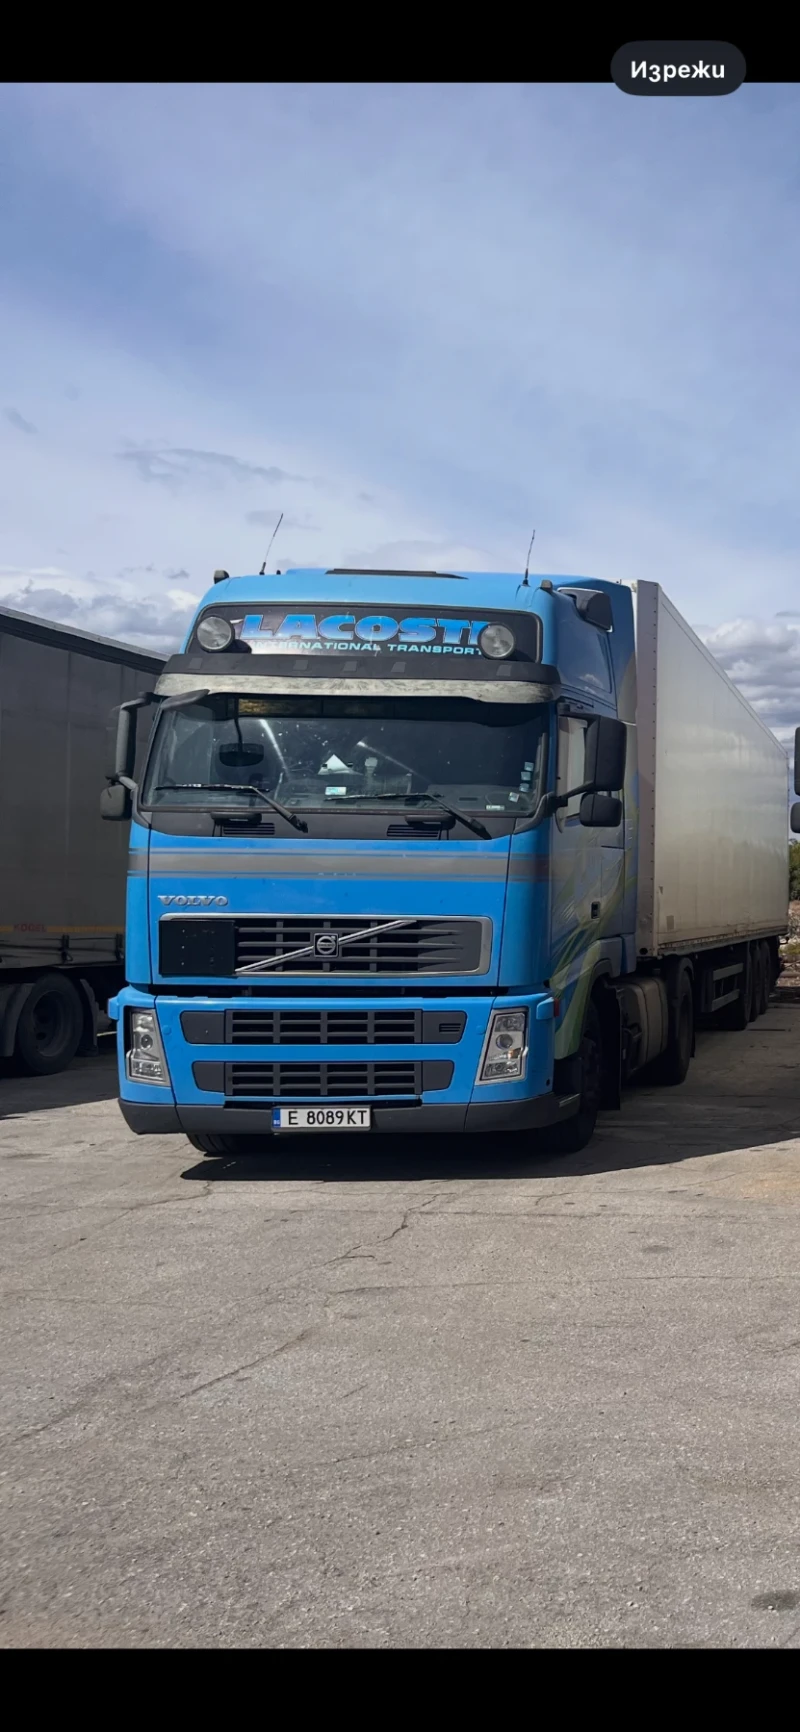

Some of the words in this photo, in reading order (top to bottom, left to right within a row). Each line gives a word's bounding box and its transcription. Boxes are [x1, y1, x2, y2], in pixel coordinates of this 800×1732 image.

[252, 641, 381, 652] INTERNATIONAL
[157, 895, 229, 906] VOLVO
[288, 1111, 299, 1126] E
